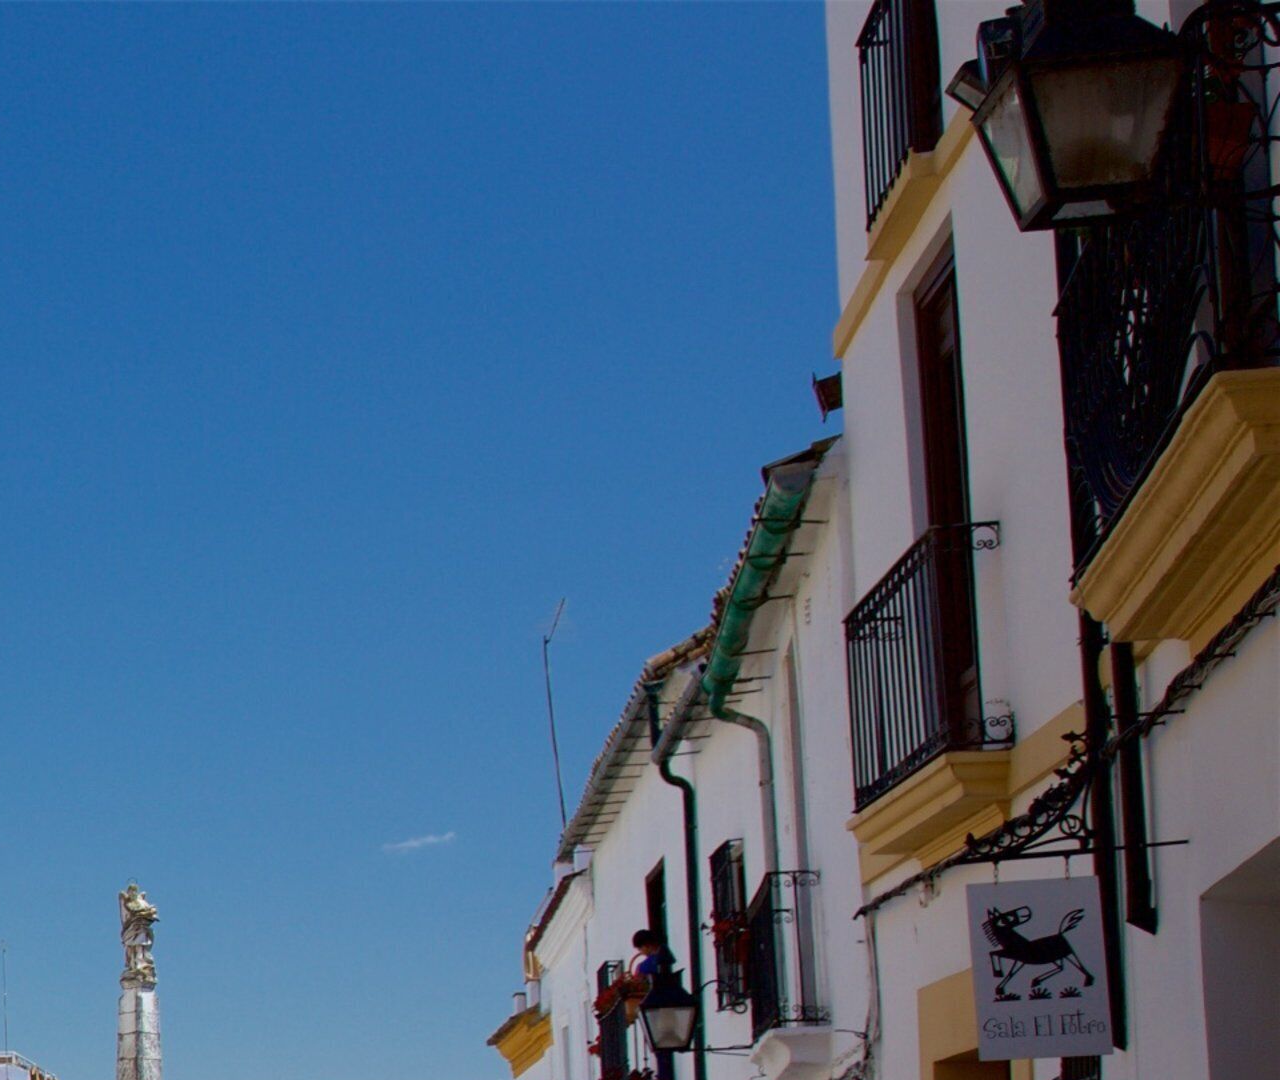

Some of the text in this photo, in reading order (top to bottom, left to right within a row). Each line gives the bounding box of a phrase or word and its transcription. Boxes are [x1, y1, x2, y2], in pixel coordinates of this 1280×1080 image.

[982, 1008, 1107, 1040] Sala El Potro
